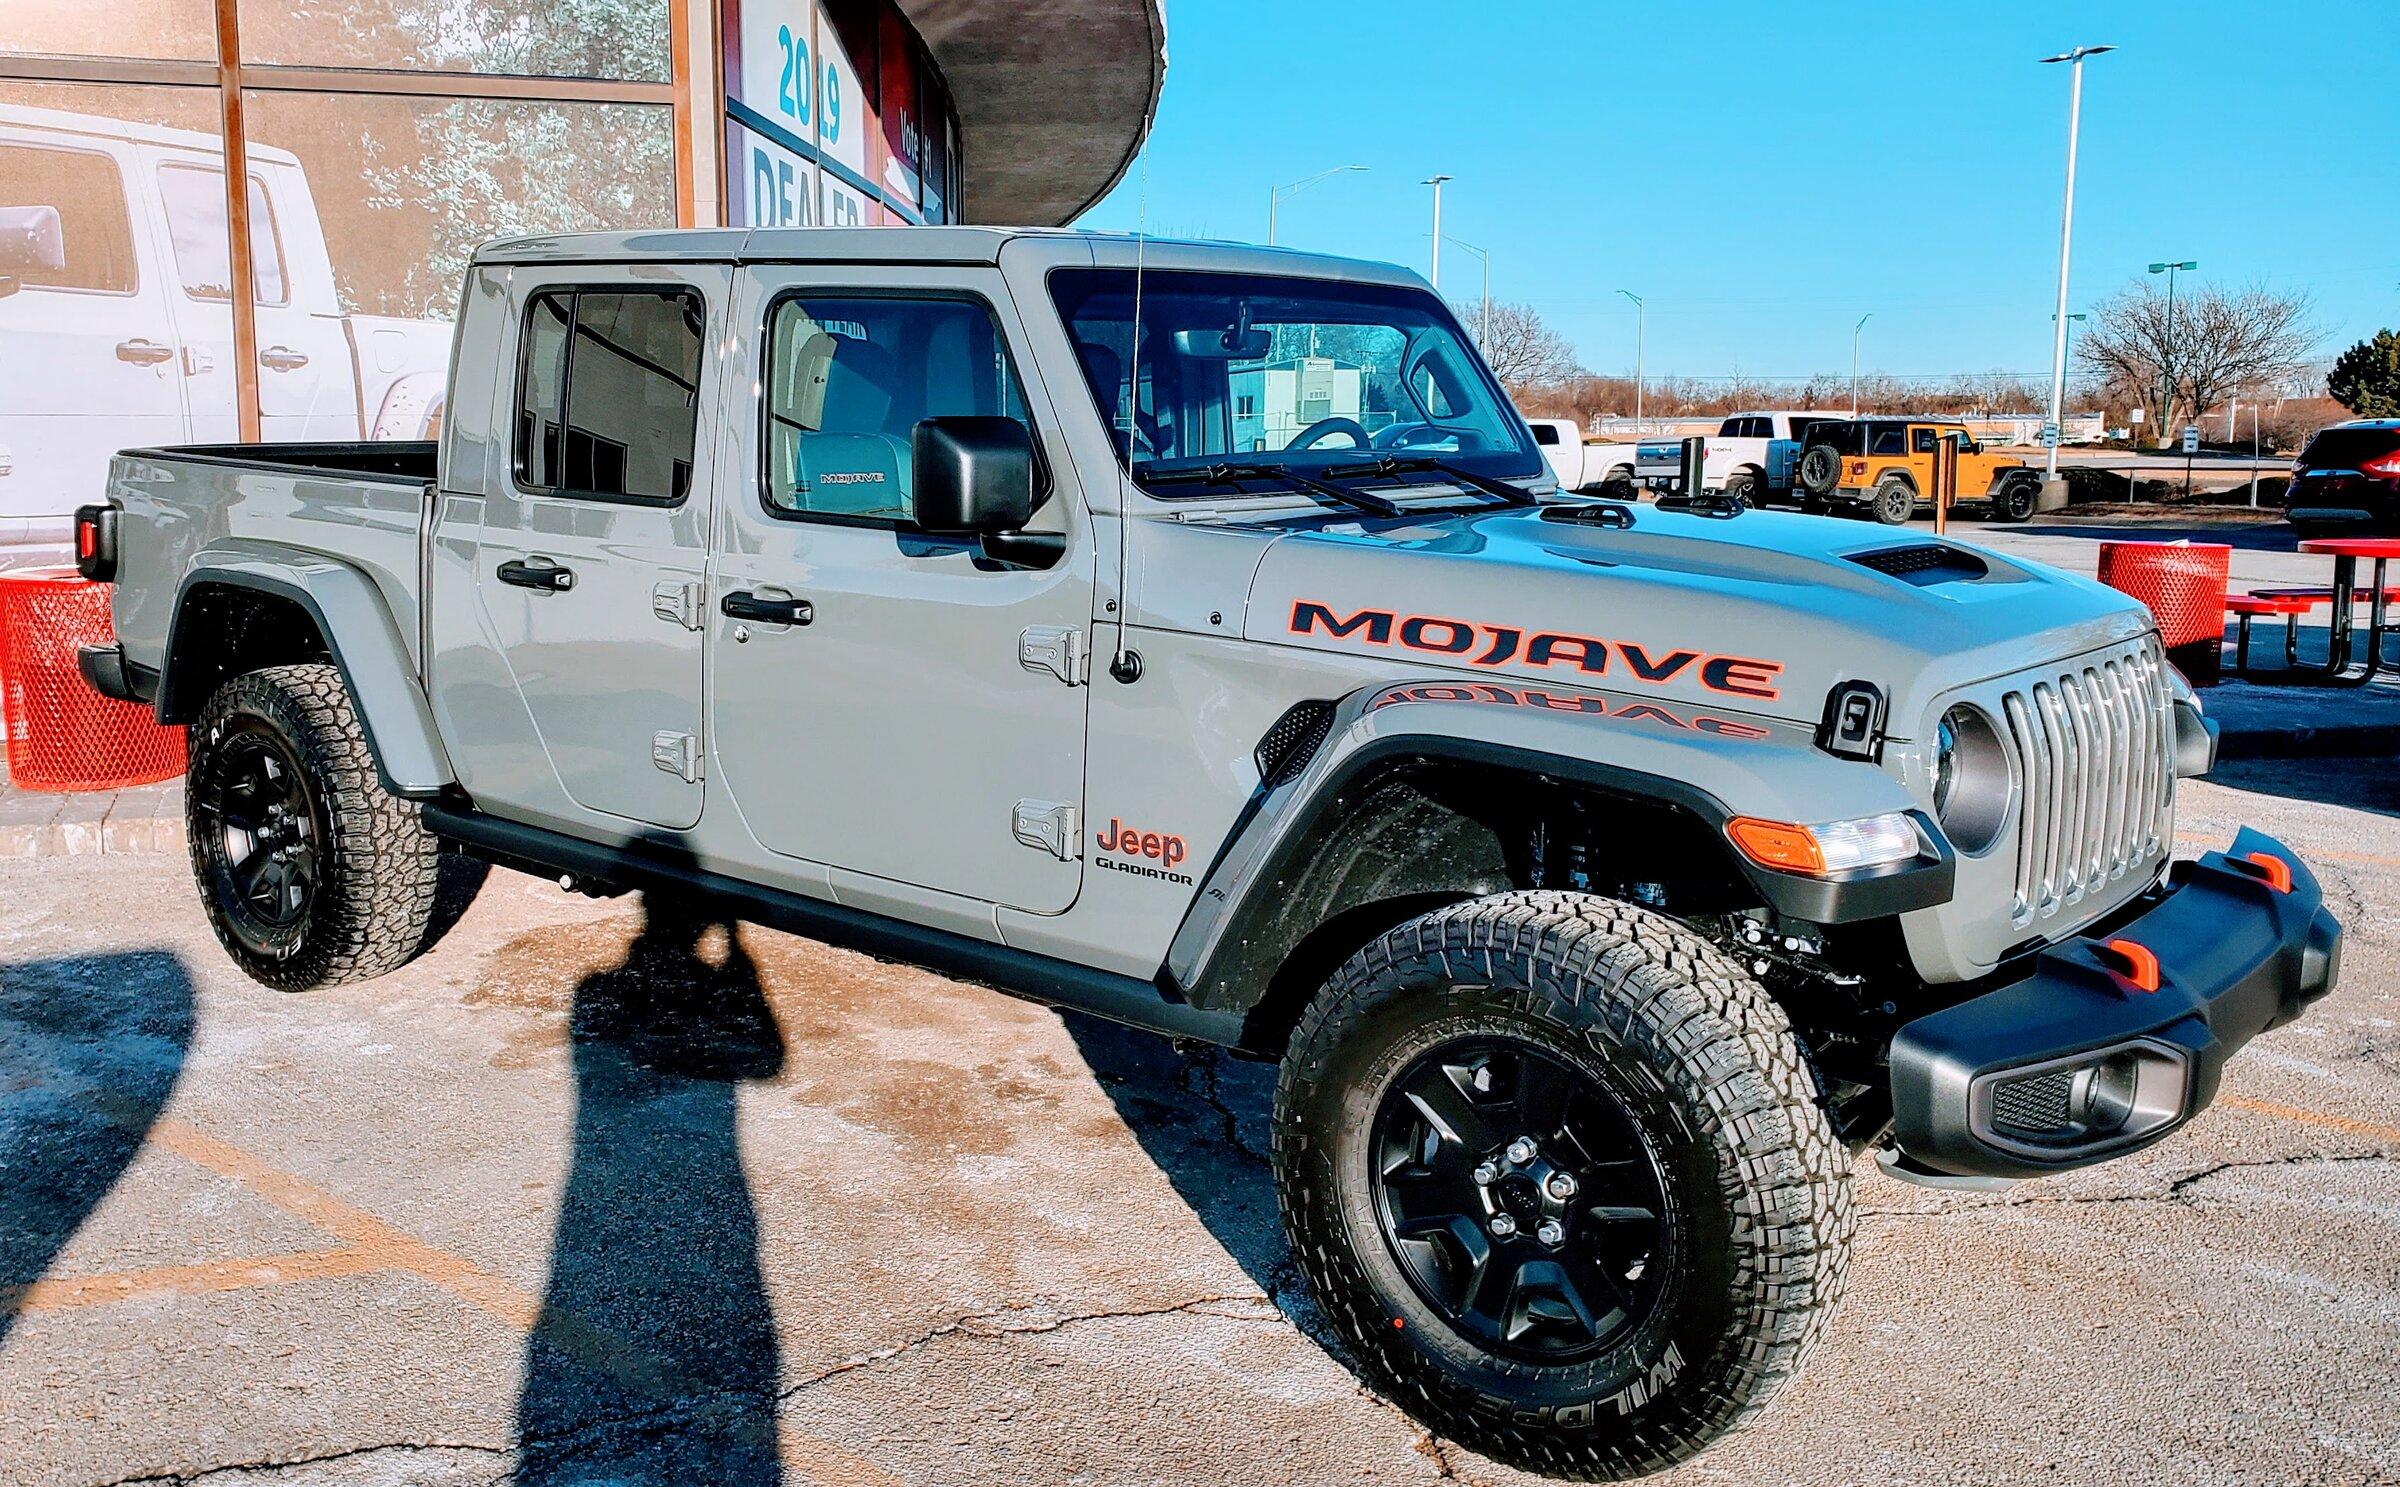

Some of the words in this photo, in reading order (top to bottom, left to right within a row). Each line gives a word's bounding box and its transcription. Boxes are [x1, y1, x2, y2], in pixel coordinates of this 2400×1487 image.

[777, 24, 841, 145] 2019
[820, 472, 884, 484] MOJAVE
[1289, 600, 1785, 702] MOJAVE
[1096, 817, 1189, 868] Jeep
[1095, 856, 1193, 886] GLADIATOR
